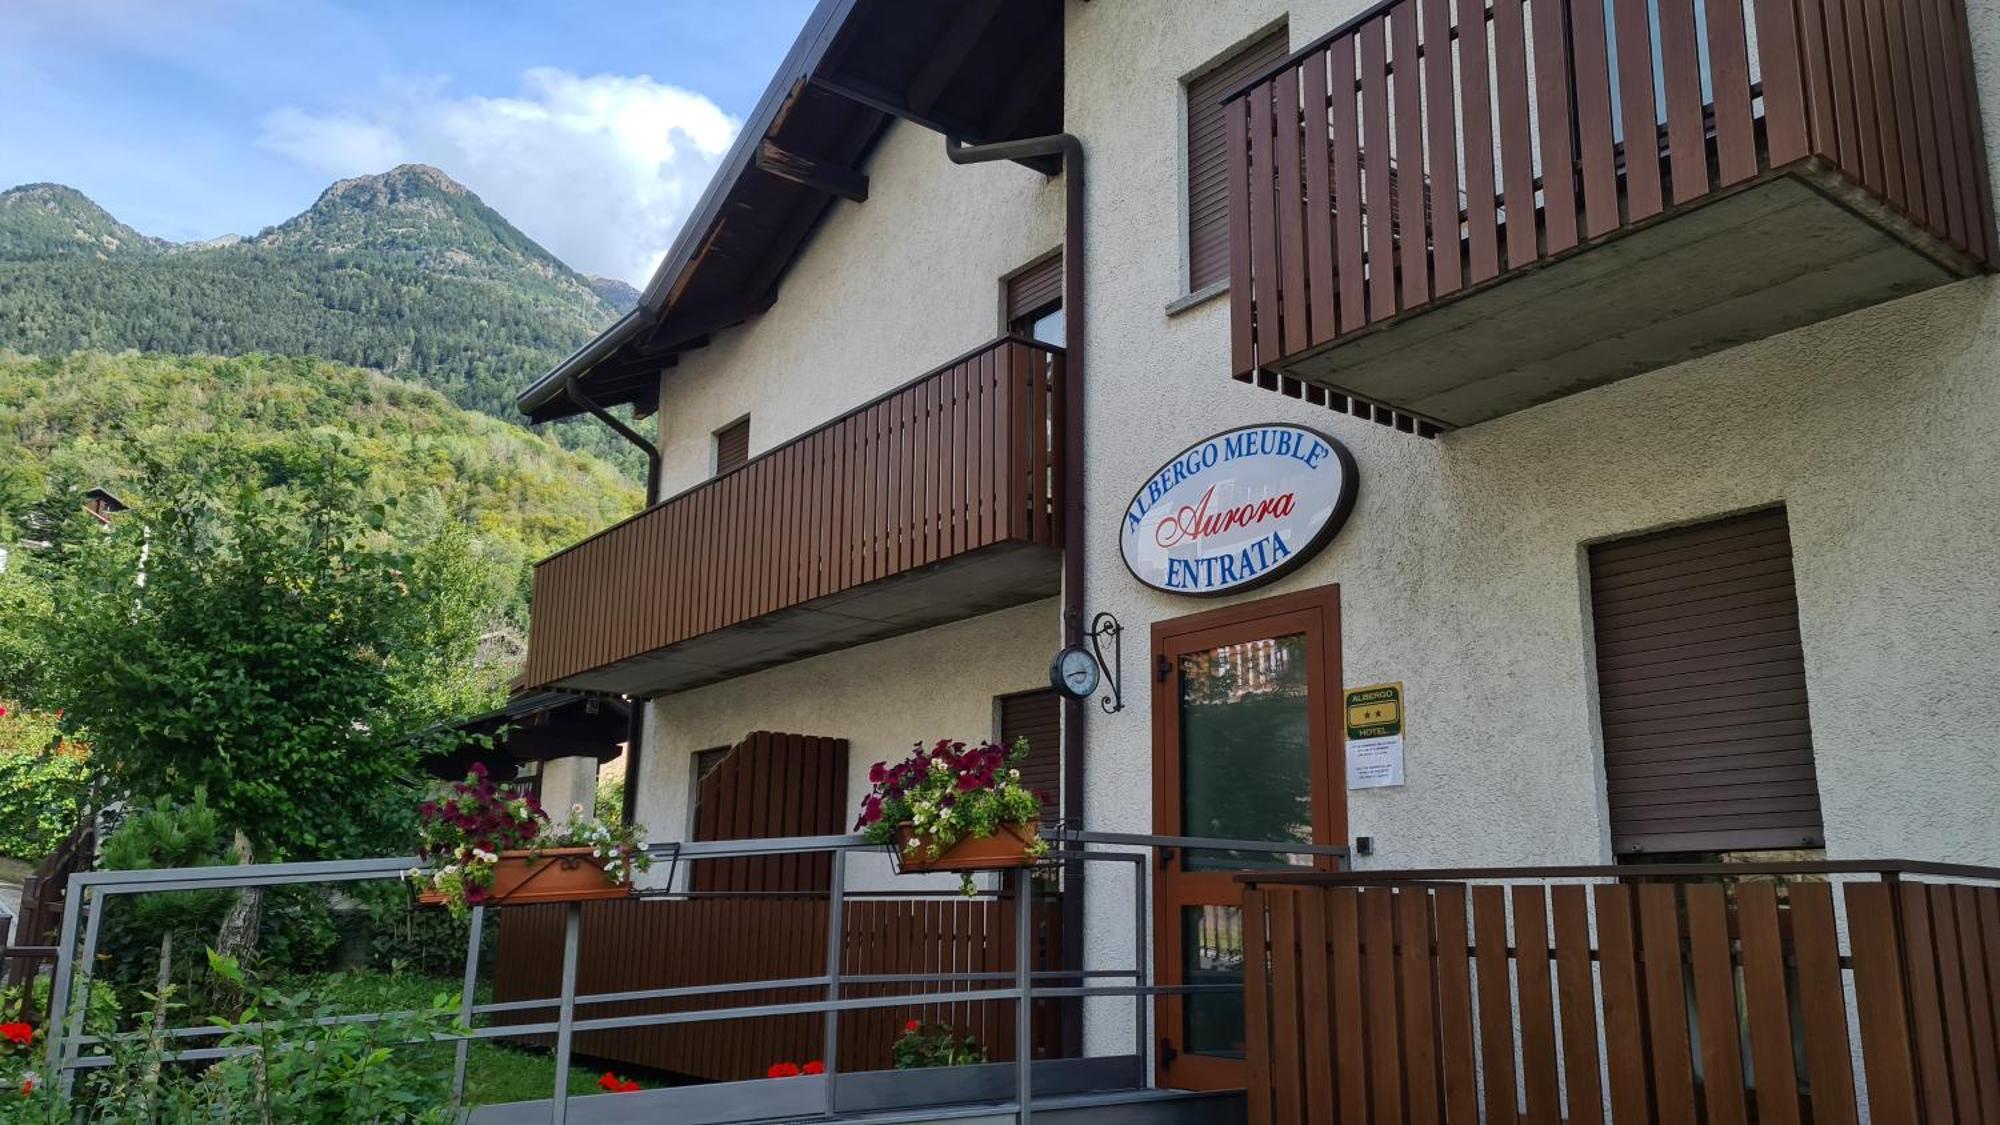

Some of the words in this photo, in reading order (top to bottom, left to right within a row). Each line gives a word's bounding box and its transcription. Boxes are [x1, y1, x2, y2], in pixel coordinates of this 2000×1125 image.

[1128, 443, 1218, 533] ALBERGO
[1156, 483, 1295, 548] Aurora
[1165, 531, 1291, 588] ENTRATA
[1352, 691, 1393, 702] ALBERGO
[1360, 727, 1386, 737] HOTEL
